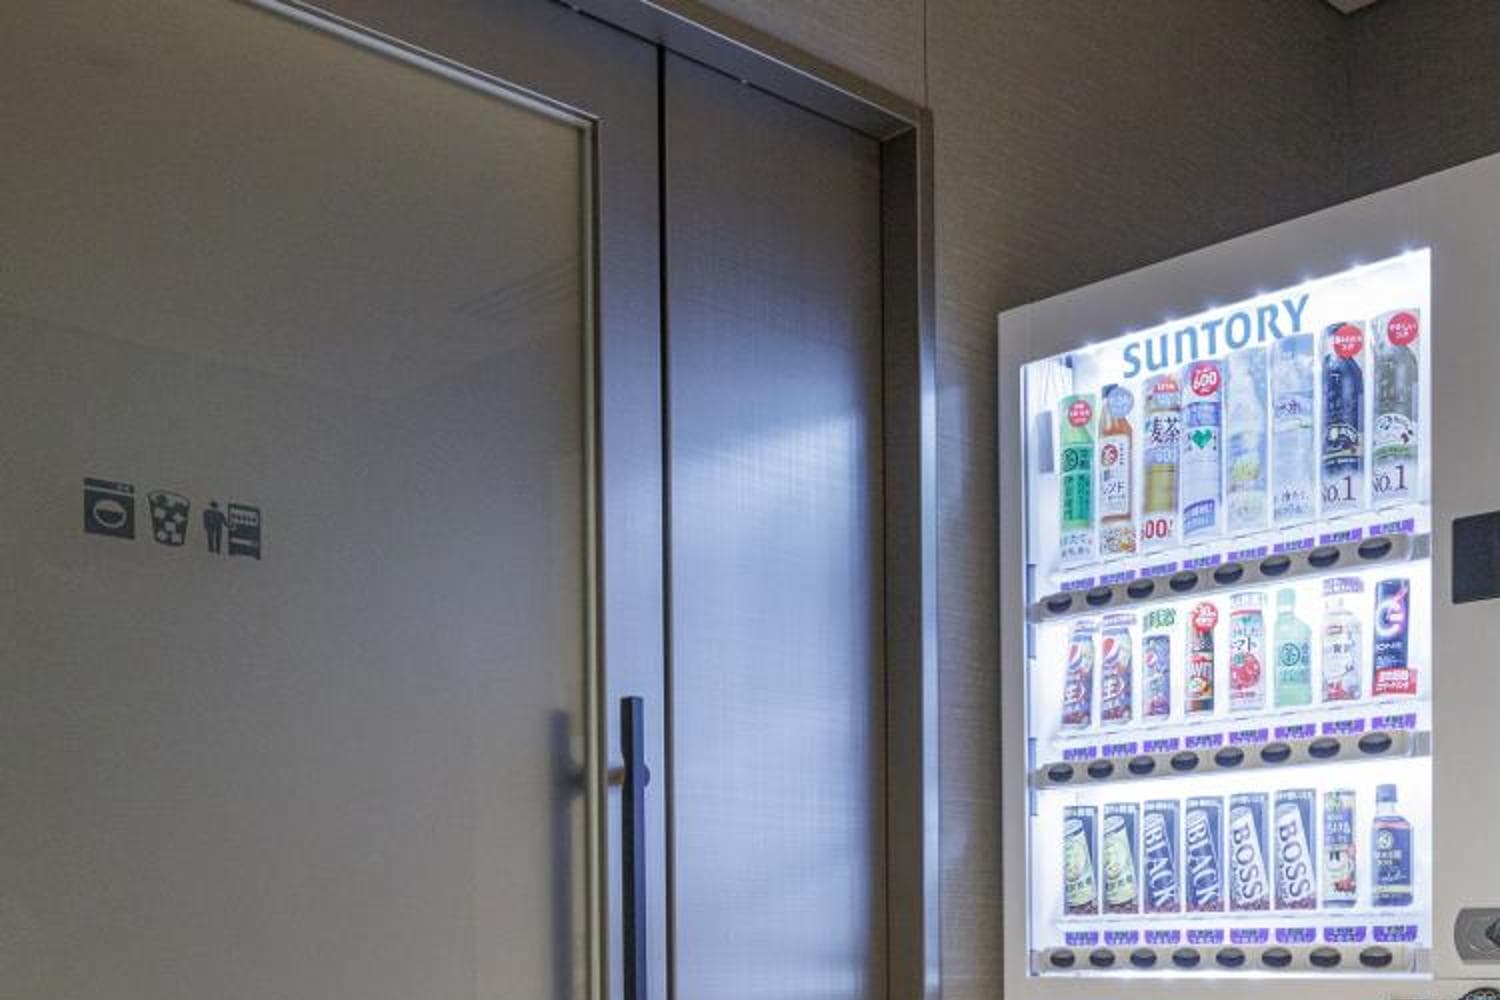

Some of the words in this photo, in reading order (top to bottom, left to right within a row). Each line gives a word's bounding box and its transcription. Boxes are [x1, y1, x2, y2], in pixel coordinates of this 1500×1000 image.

[1123, 295, 1310, 378] SUNTORY
[1145, 826, 1177, 907] BLACK
[1186, 822, 1219, 905] BLACK
[1233, 822, 1262, 898] BOSS
[1279, 820, 1310, 897] BOSS
